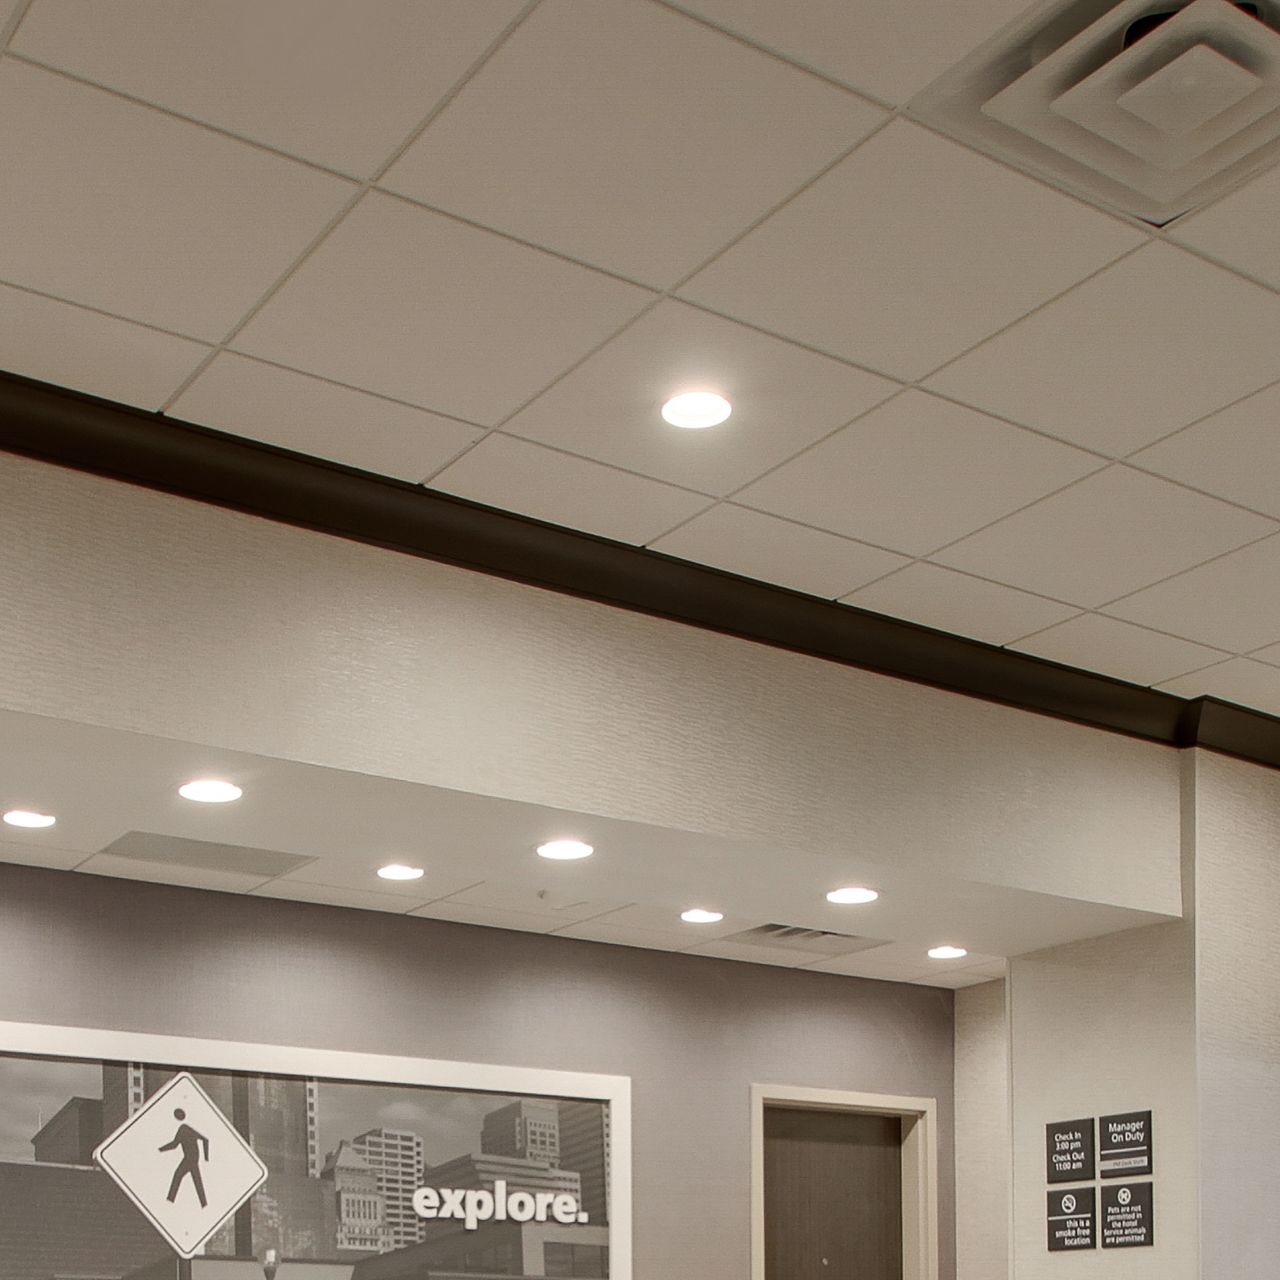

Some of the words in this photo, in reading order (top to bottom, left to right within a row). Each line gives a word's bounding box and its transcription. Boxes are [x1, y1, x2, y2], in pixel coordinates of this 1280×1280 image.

[1108, 1121, 1144, 1133] Manager
[1054, 1131, 1073, 1142] Check
[1074, 1131, 1082, 1140] In
[1111, 1134, 1124, 1143] On
[1125, 1131, 1144, 1142] Duty
[1055, 1141, 1070, 1151] 3:00
[1070, 1141, 1081, 1150] pm
[1052, 1153, 1071, 1163] Check
[1072, 1151, 1085, 1161] Out
[1055, 1162, 1071, 1171] 11:00
[1072, 1161, 1083, 1170] am
[412, 1180, 589, 1230] explore.
[1107, 1213, 1135, 1222] permitted
[1066, 1219, 1078, 1228] this
[1079, 1219, 1085, 1227] is
[1055, 1228, 1076, 1238] smoke
[1076, 1227, 1090, 1236] free
[1064, 1237, 1091, 1246] location
[1116, 1234, 1145, 1244] permitted
